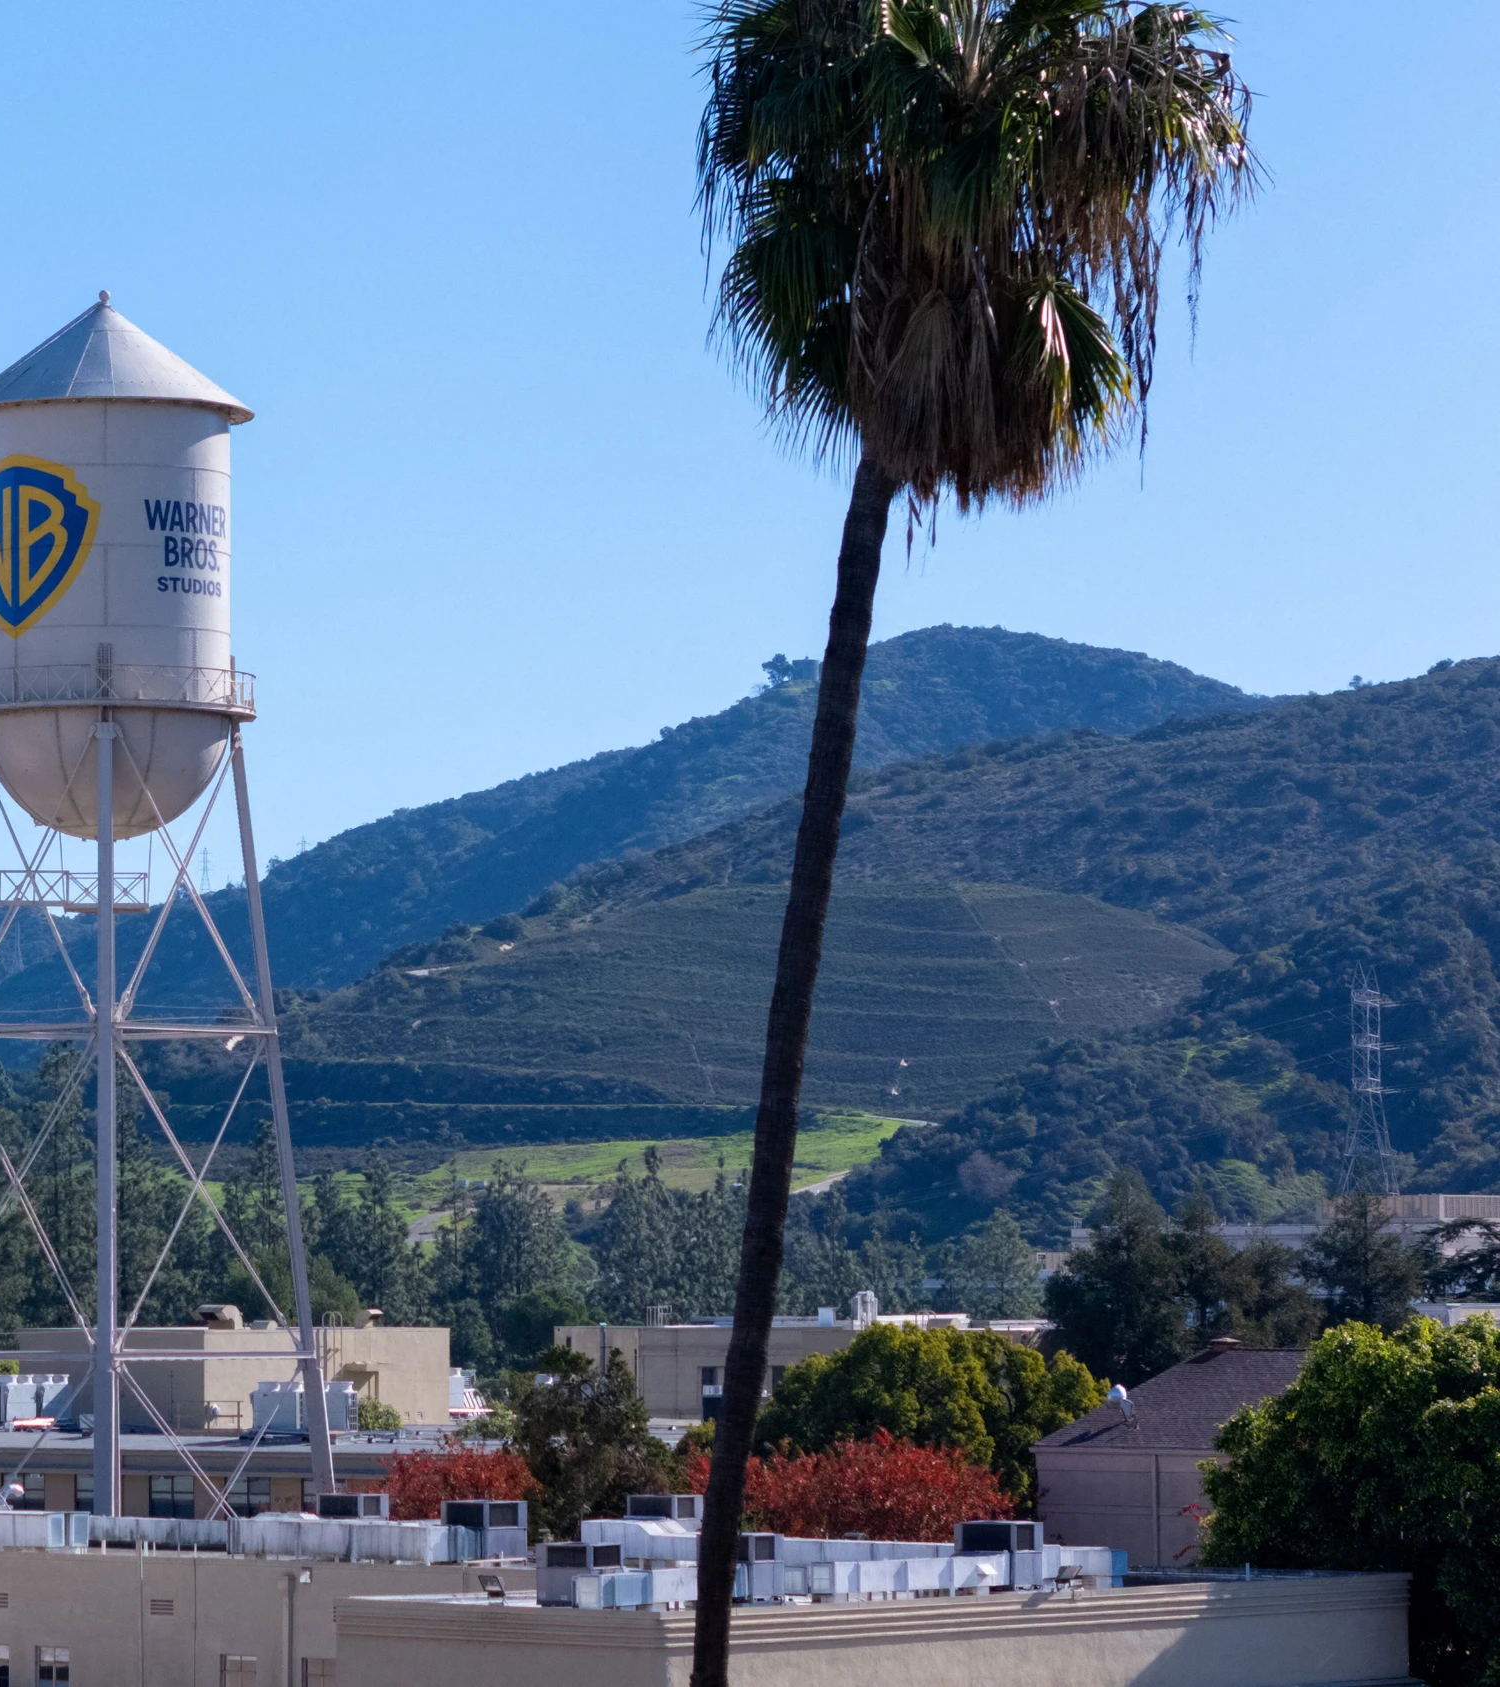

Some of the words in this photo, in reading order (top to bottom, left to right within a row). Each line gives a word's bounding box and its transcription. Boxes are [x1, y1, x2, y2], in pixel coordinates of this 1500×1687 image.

[144, 499, 226, 539] WARNER
[164, 536, 220, 572] BROS.
[157, 576, 222, 598] STUDIOS
